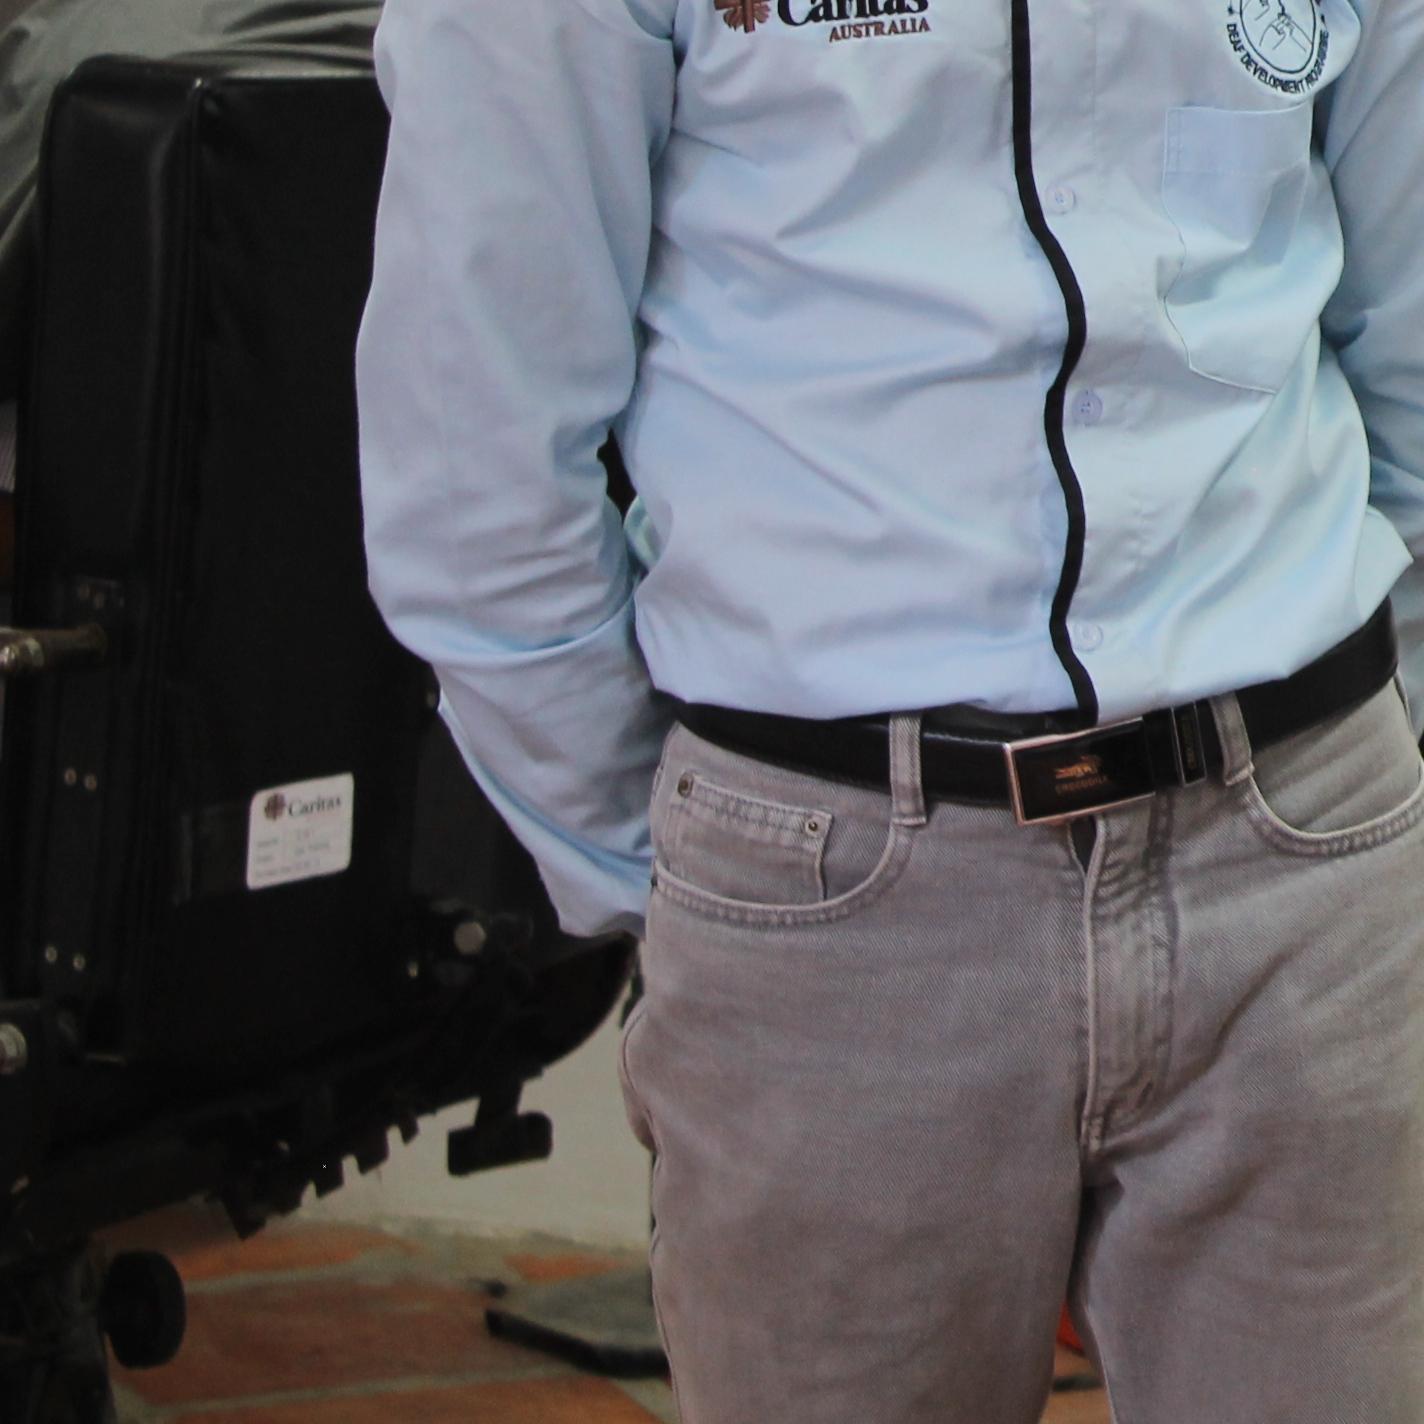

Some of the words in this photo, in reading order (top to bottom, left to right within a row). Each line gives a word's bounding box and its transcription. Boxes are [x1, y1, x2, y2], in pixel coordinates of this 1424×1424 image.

[829, 17, 931, 43] AUSTRALIA
[1226, 23, 1246, 53] DEAF
[1240, 51, 1306, 94] DEVELOPMENT
[287, 794, 342, 818] Caritas
